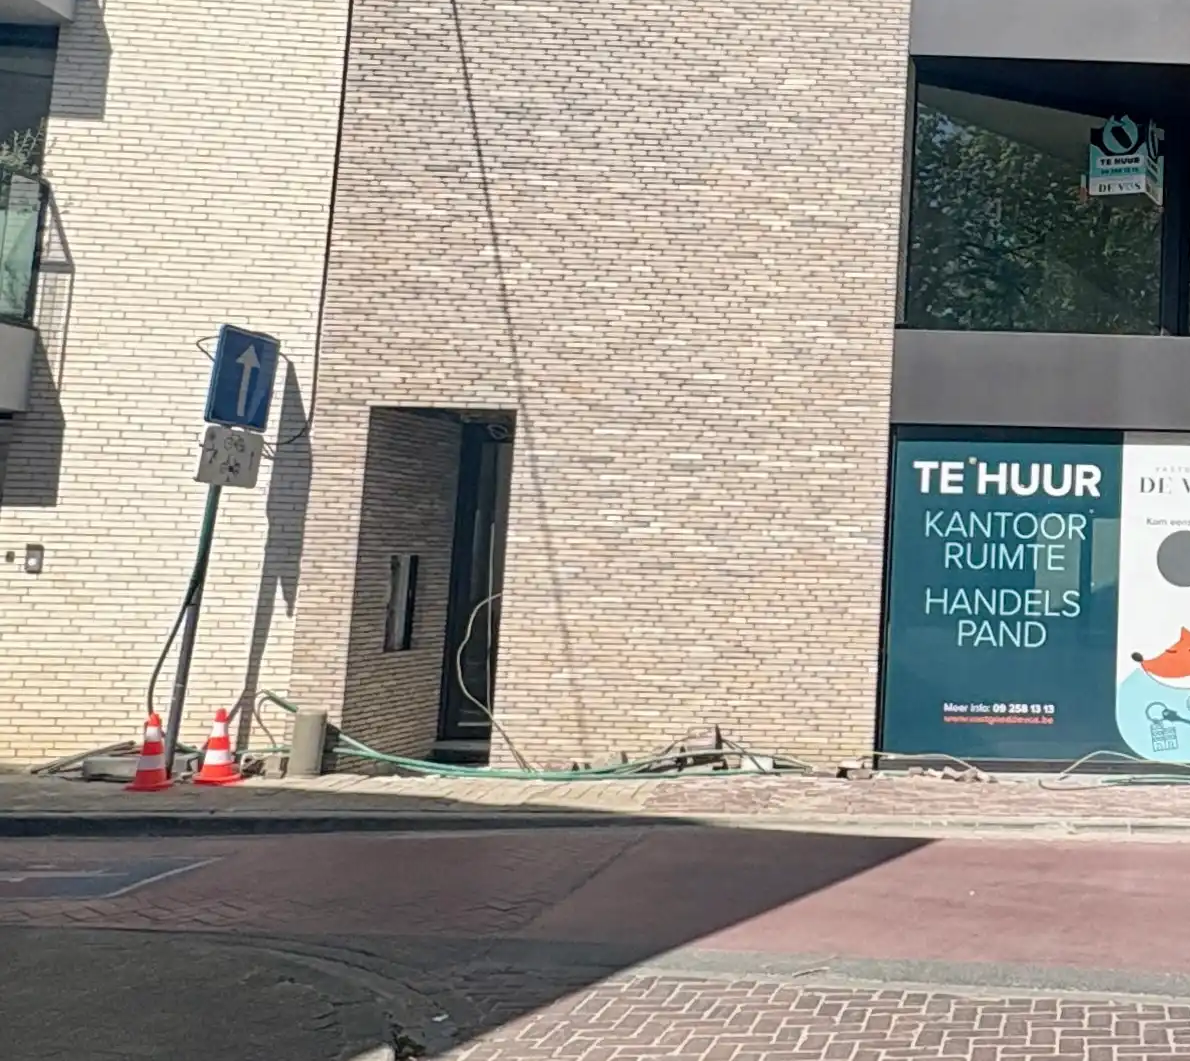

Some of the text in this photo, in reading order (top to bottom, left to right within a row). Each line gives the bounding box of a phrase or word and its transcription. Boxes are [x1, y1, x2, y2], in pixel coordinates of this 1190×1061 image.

[1100, 157, 1140, 166] TE HUUR
[913, 461, 1102, 498] TE HUUR
[1139, 476, 1172, 494] DE
[925, 511, 1087, 540] KANTOOR
[1146, 517, 1167, 526] Kom
[944, 543, 1066, 572] RUIMTE
[924, 588, 1081, 618] HANDELS
[957, 621, 1047, 648] PAND
[943, 703, 968, 713] Meer
[992, 704, 1006, 714] 09
[1008, 703, 1028, 714] 258
[1030, 703, 1041, 714] 13
[1043, 704, 1055, 714] 13
